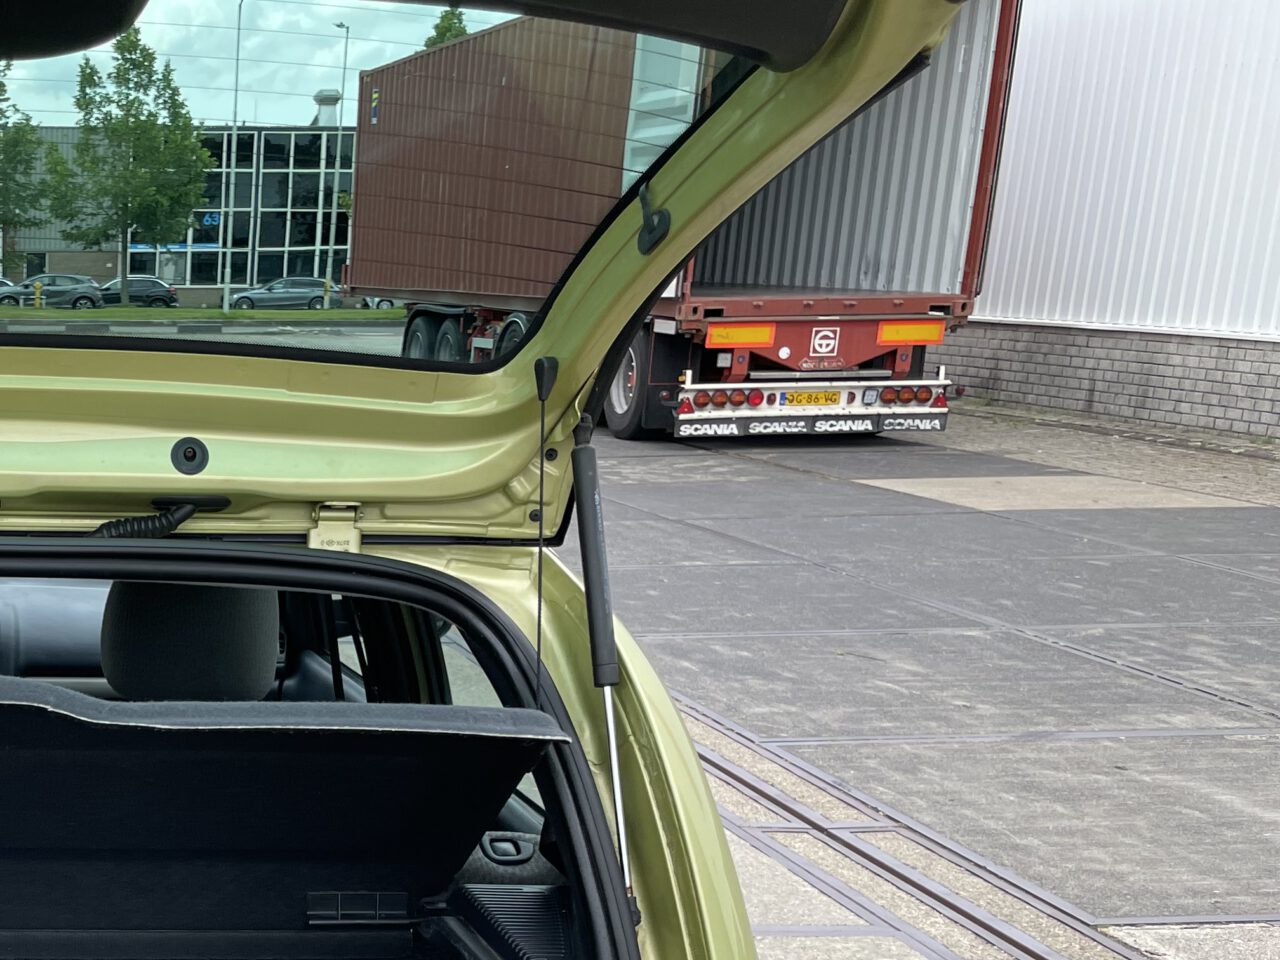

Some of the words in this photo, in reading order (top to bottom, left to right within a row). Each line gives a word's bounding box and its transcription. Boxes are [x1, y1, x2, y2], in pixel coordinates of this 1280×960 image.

[203, 212, 221, 226] 63
[679, 423, 739, 436] SCANIA
[748, 421, 807, 433] SCANIA
[814, 419, 873, 432] SCANIA
[882, 418, 941, 430] SCANIA
